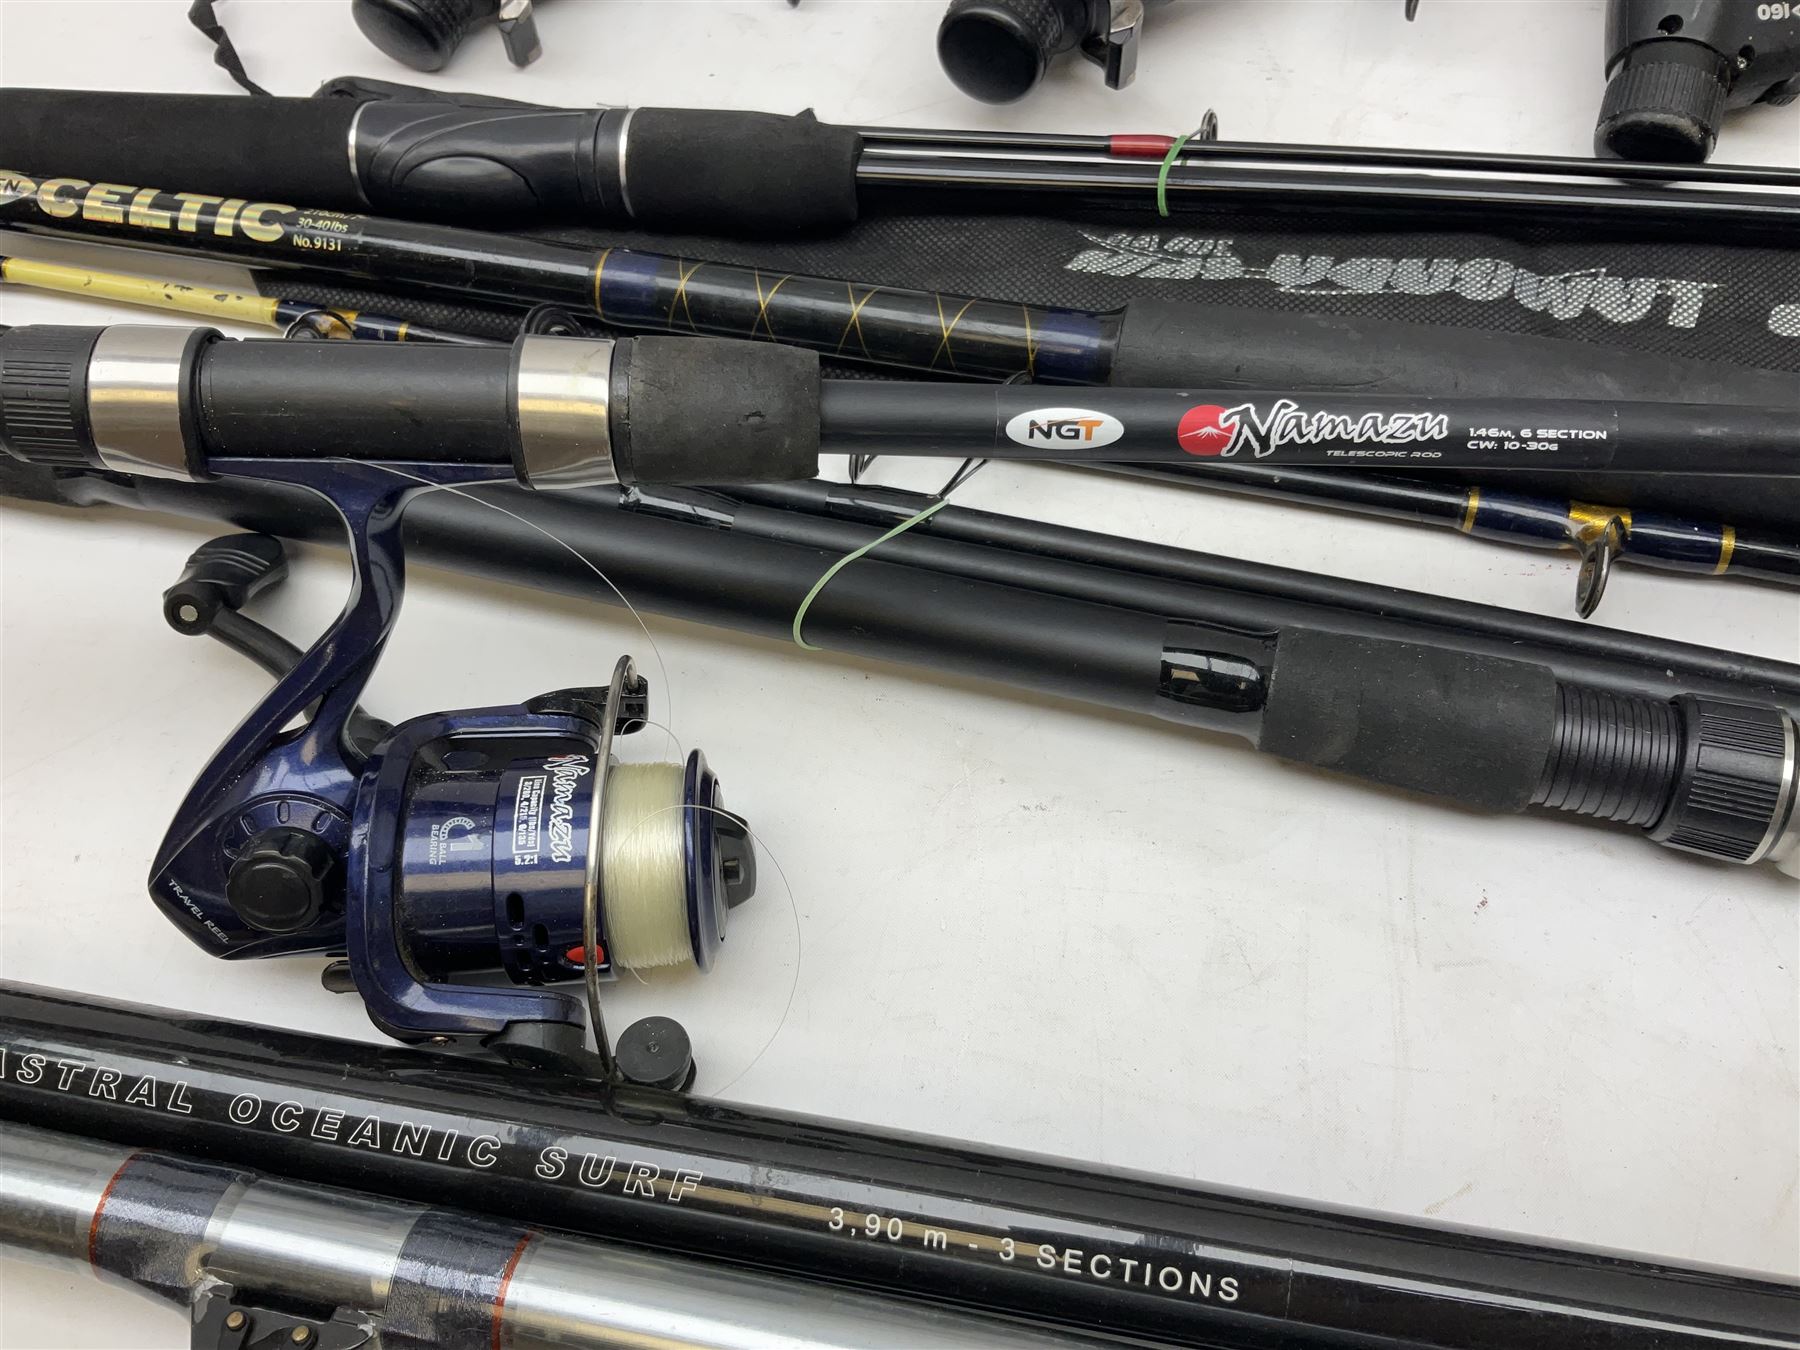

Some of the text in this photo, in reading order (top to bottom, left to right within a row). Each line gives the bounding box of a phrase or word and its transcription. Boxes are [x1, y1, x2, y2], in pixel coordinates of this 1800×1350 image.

[1757, 2, 1790, 21] 160
[36, 178, 297, 242] CELTIC
[293, 234, 342, 251] No.9131
[1028, 419, 1104, 441] NGT
[1218, 399, 1448, 458] Namazu
[1520, 428, 1532, 438] 6
[1536, 429, 1607, 440] SECTION
[1326, 449, 1406, 458] TELESCOPIC
[1467, 440, 1498, 450] CW:
[543, 754, 590, 863] Namazu
[429, 824, 440, 865] BEARING
[438, 842, 447, 866] BALL
[514, 854, 539, 866] 5.2:1
[168, 878, 229, 944] TRAVEL REEL
[0, 1048, 703, 1202] STRAL OCEANIC SURF
[828, 1207, 903, 1240] 3,90
[924, 1228, 947, 1250] m
[999, 1238, 1015, 1262] 3
[1037, 1244, 1240, 1302] SECTIONS
